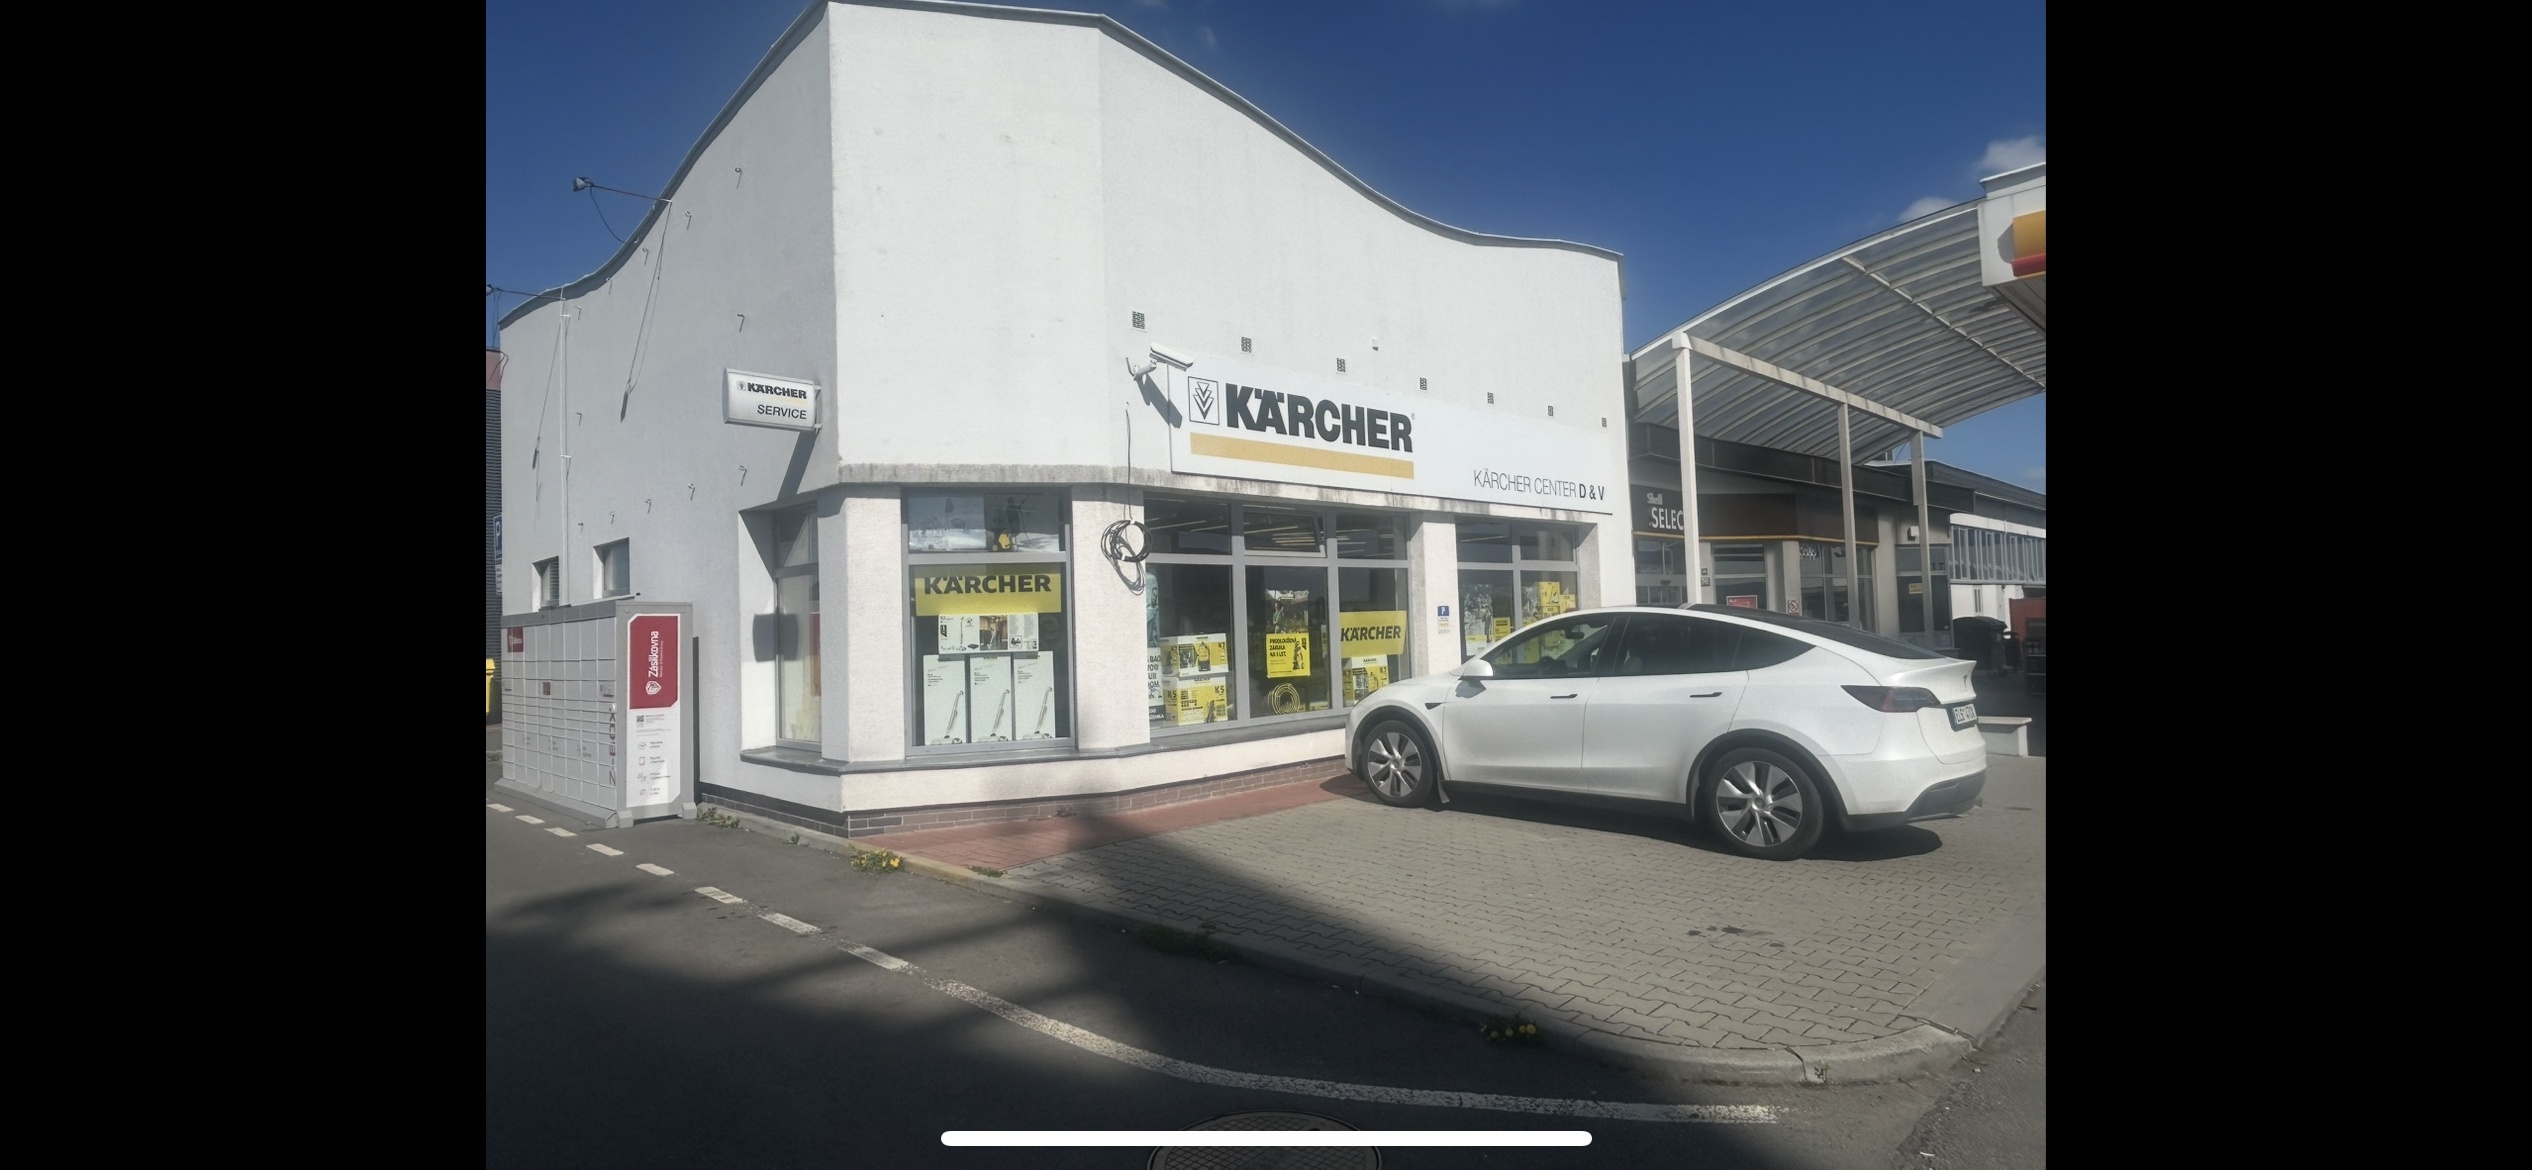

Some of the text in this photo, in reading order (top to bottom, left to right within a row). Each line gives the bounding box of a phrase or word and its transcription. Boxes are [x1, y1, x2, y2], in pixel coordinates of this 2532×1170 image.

[747, 382, 807, 399] KÄRCHER
[757, 404, 807, 420] SERVICE
[1226, 383, 1413, 453] KÄRCHER
[1474, 468, 1605, 500] KÄRCHER CENTER D & V
[1651, 506, 1684, 531] SELEC
[924, 574, 1052, 595] KÄRCHER
[1340, 625, 1402, 642] KÄRCHER
[648, 630, 659, 678] Zásilkovna
